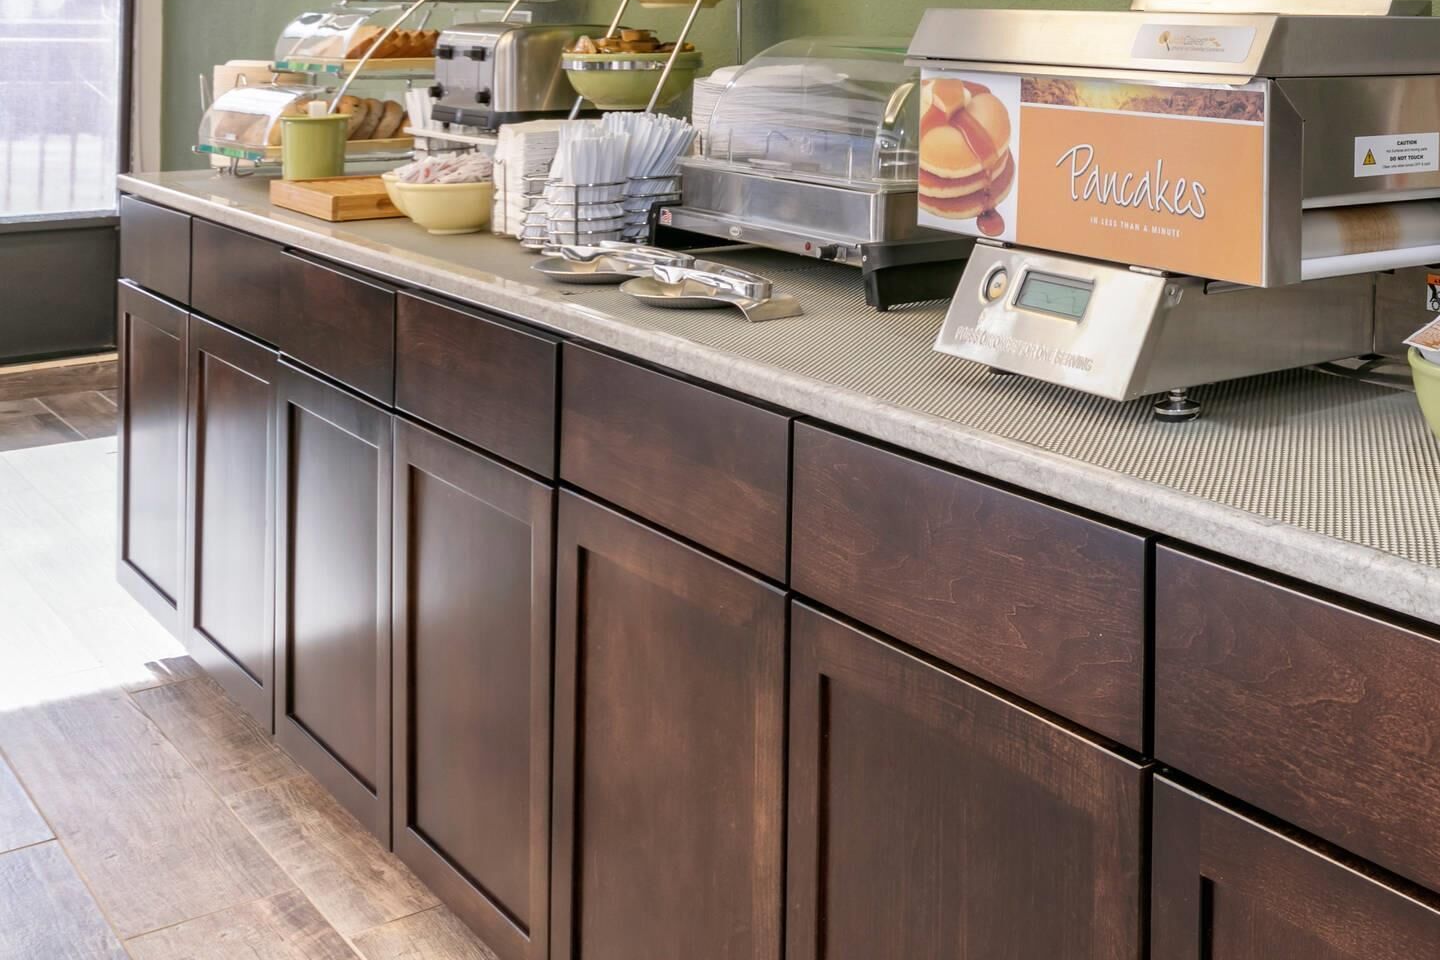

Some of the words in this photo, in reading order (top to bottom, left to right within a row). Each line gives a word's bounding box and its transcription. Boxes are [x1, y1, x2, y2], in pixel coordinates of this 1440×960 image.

[1055, 143, 1206, 219] Pancakes
[1120, 220, 1140, 231] THAN
[1152, 225, 1180, 238] MINUTE
